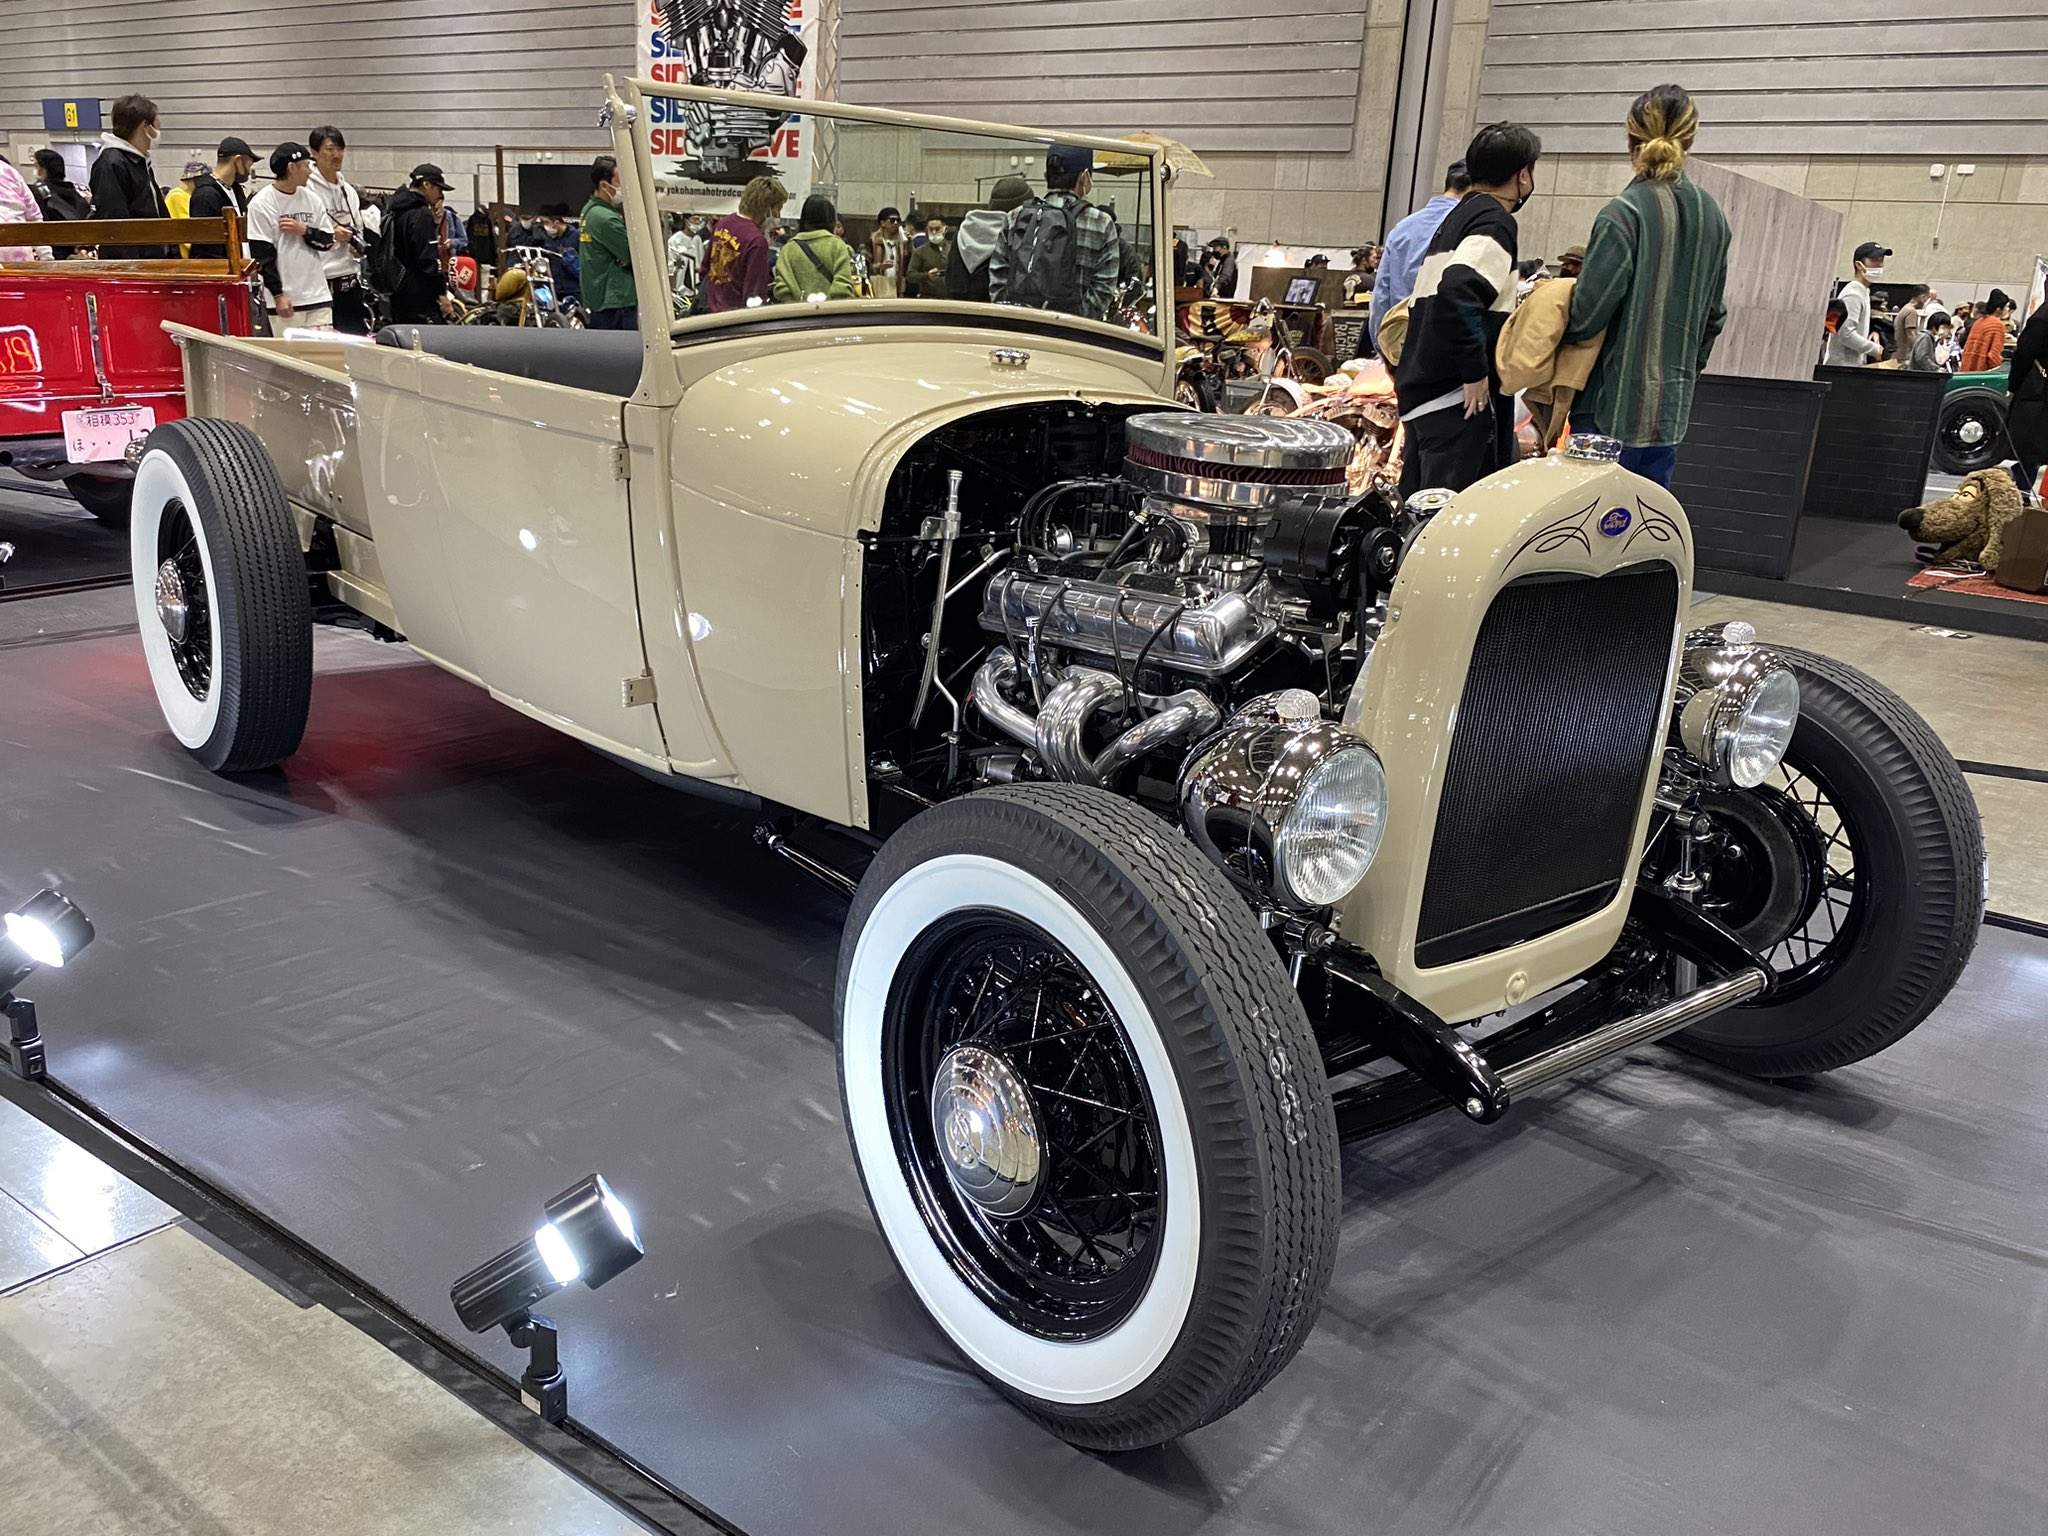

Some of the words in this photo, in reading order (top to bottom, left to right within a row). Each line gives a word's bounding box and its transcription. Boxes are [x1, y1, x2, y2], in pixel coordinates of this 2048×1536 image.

[66, 108, 76, 122] G1
[1334, 323, 1348, 361] RACING
[1603, 511, 1629, 530] Ford
